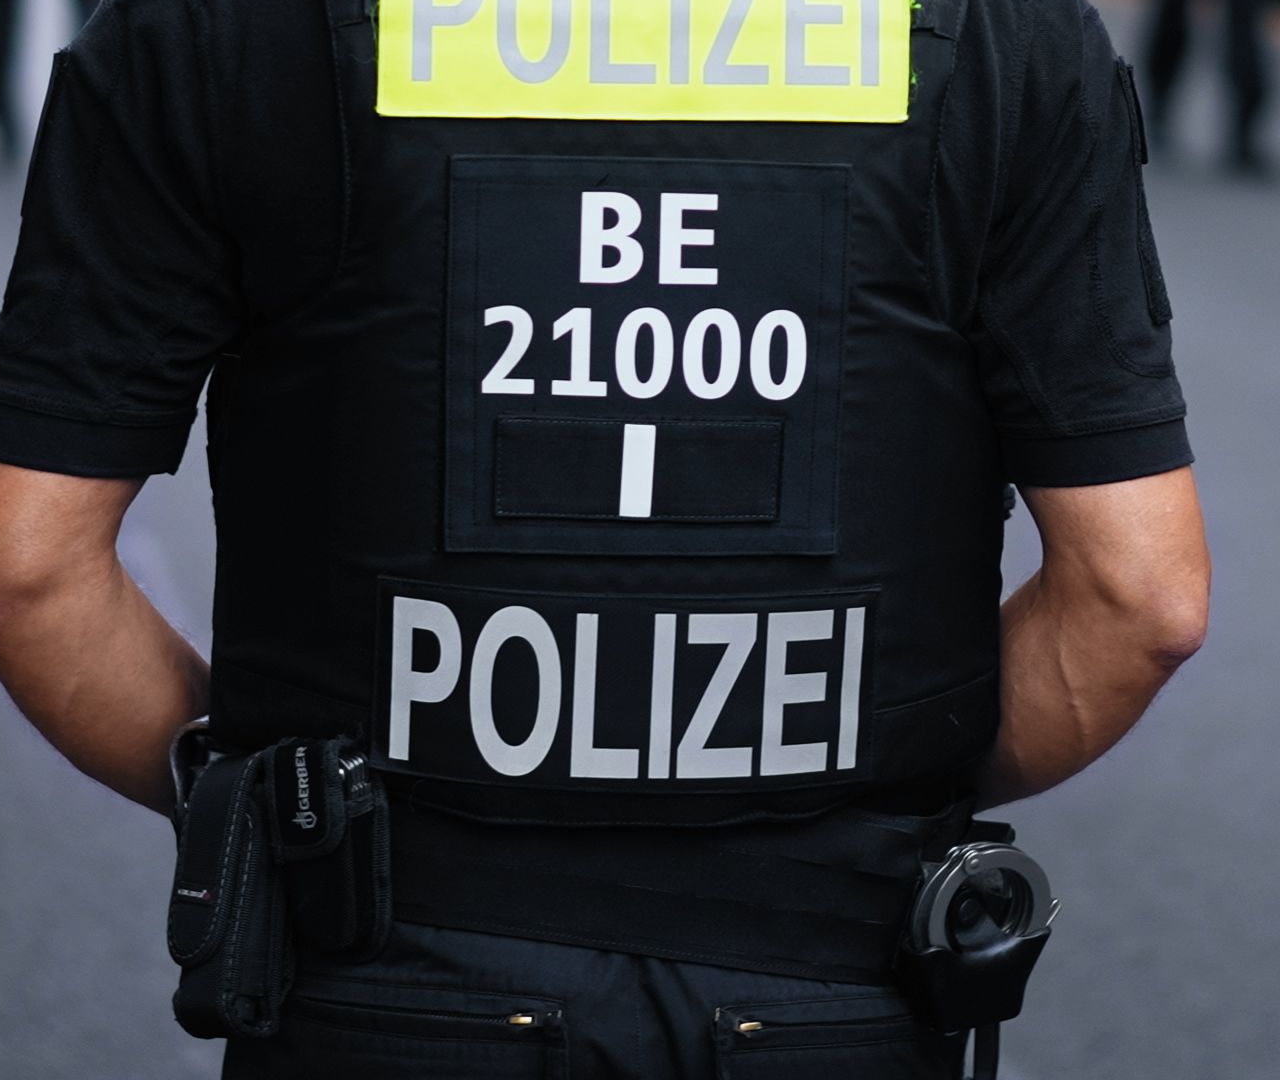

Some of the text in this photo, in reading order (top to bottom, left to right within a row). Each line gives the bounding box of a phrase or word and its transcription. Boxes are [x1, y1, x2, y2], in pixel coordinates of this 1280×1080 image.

[579, 191, 719, 285] BE
[481, 305, 808, 401] 21000
[388, 596, 867, 780] POLIZEI
[295, 746, 310, 810] GERBER
